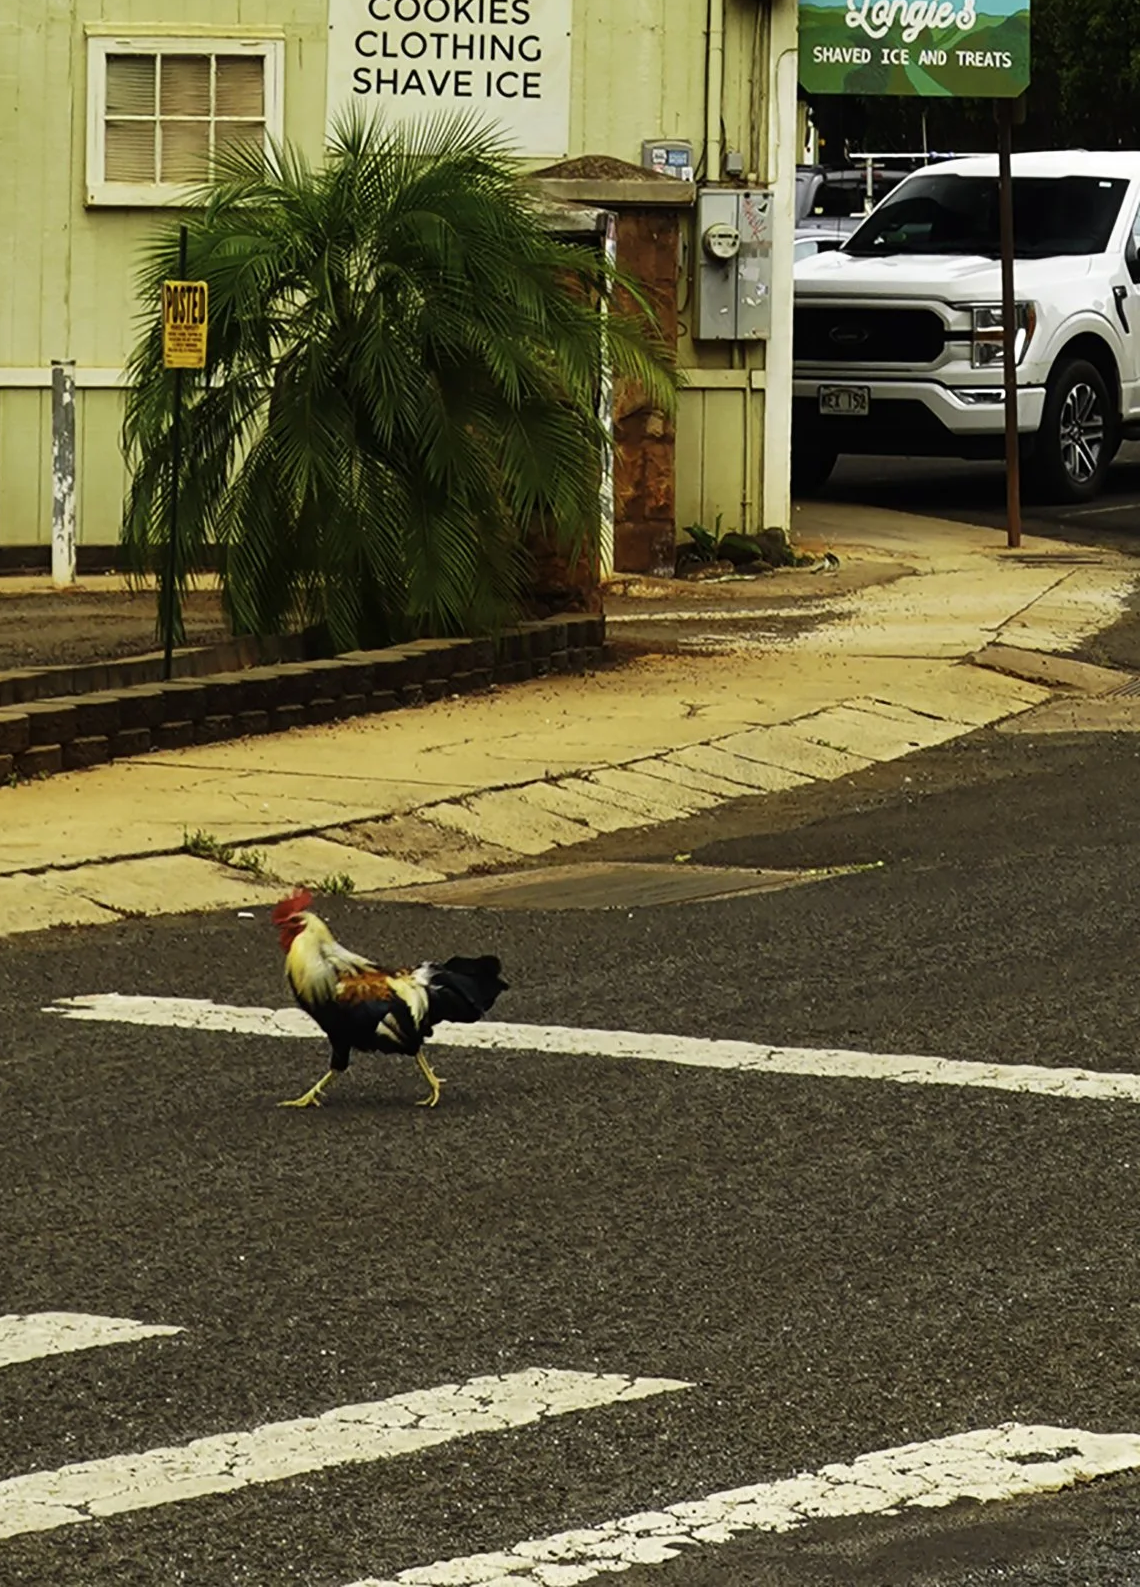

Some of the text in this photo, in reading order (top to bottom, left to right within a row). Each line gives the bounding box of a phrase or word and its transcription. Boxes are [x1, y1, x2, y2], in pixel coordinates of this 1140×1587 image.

[354, 30, 542, 62] CLOTHING
[813, 45, 1013, 68] SHAVED ICE AND TREATS
[352, 67, 542, 99] SHAVE ICE
[165, 284, 206, 324] POSTED
